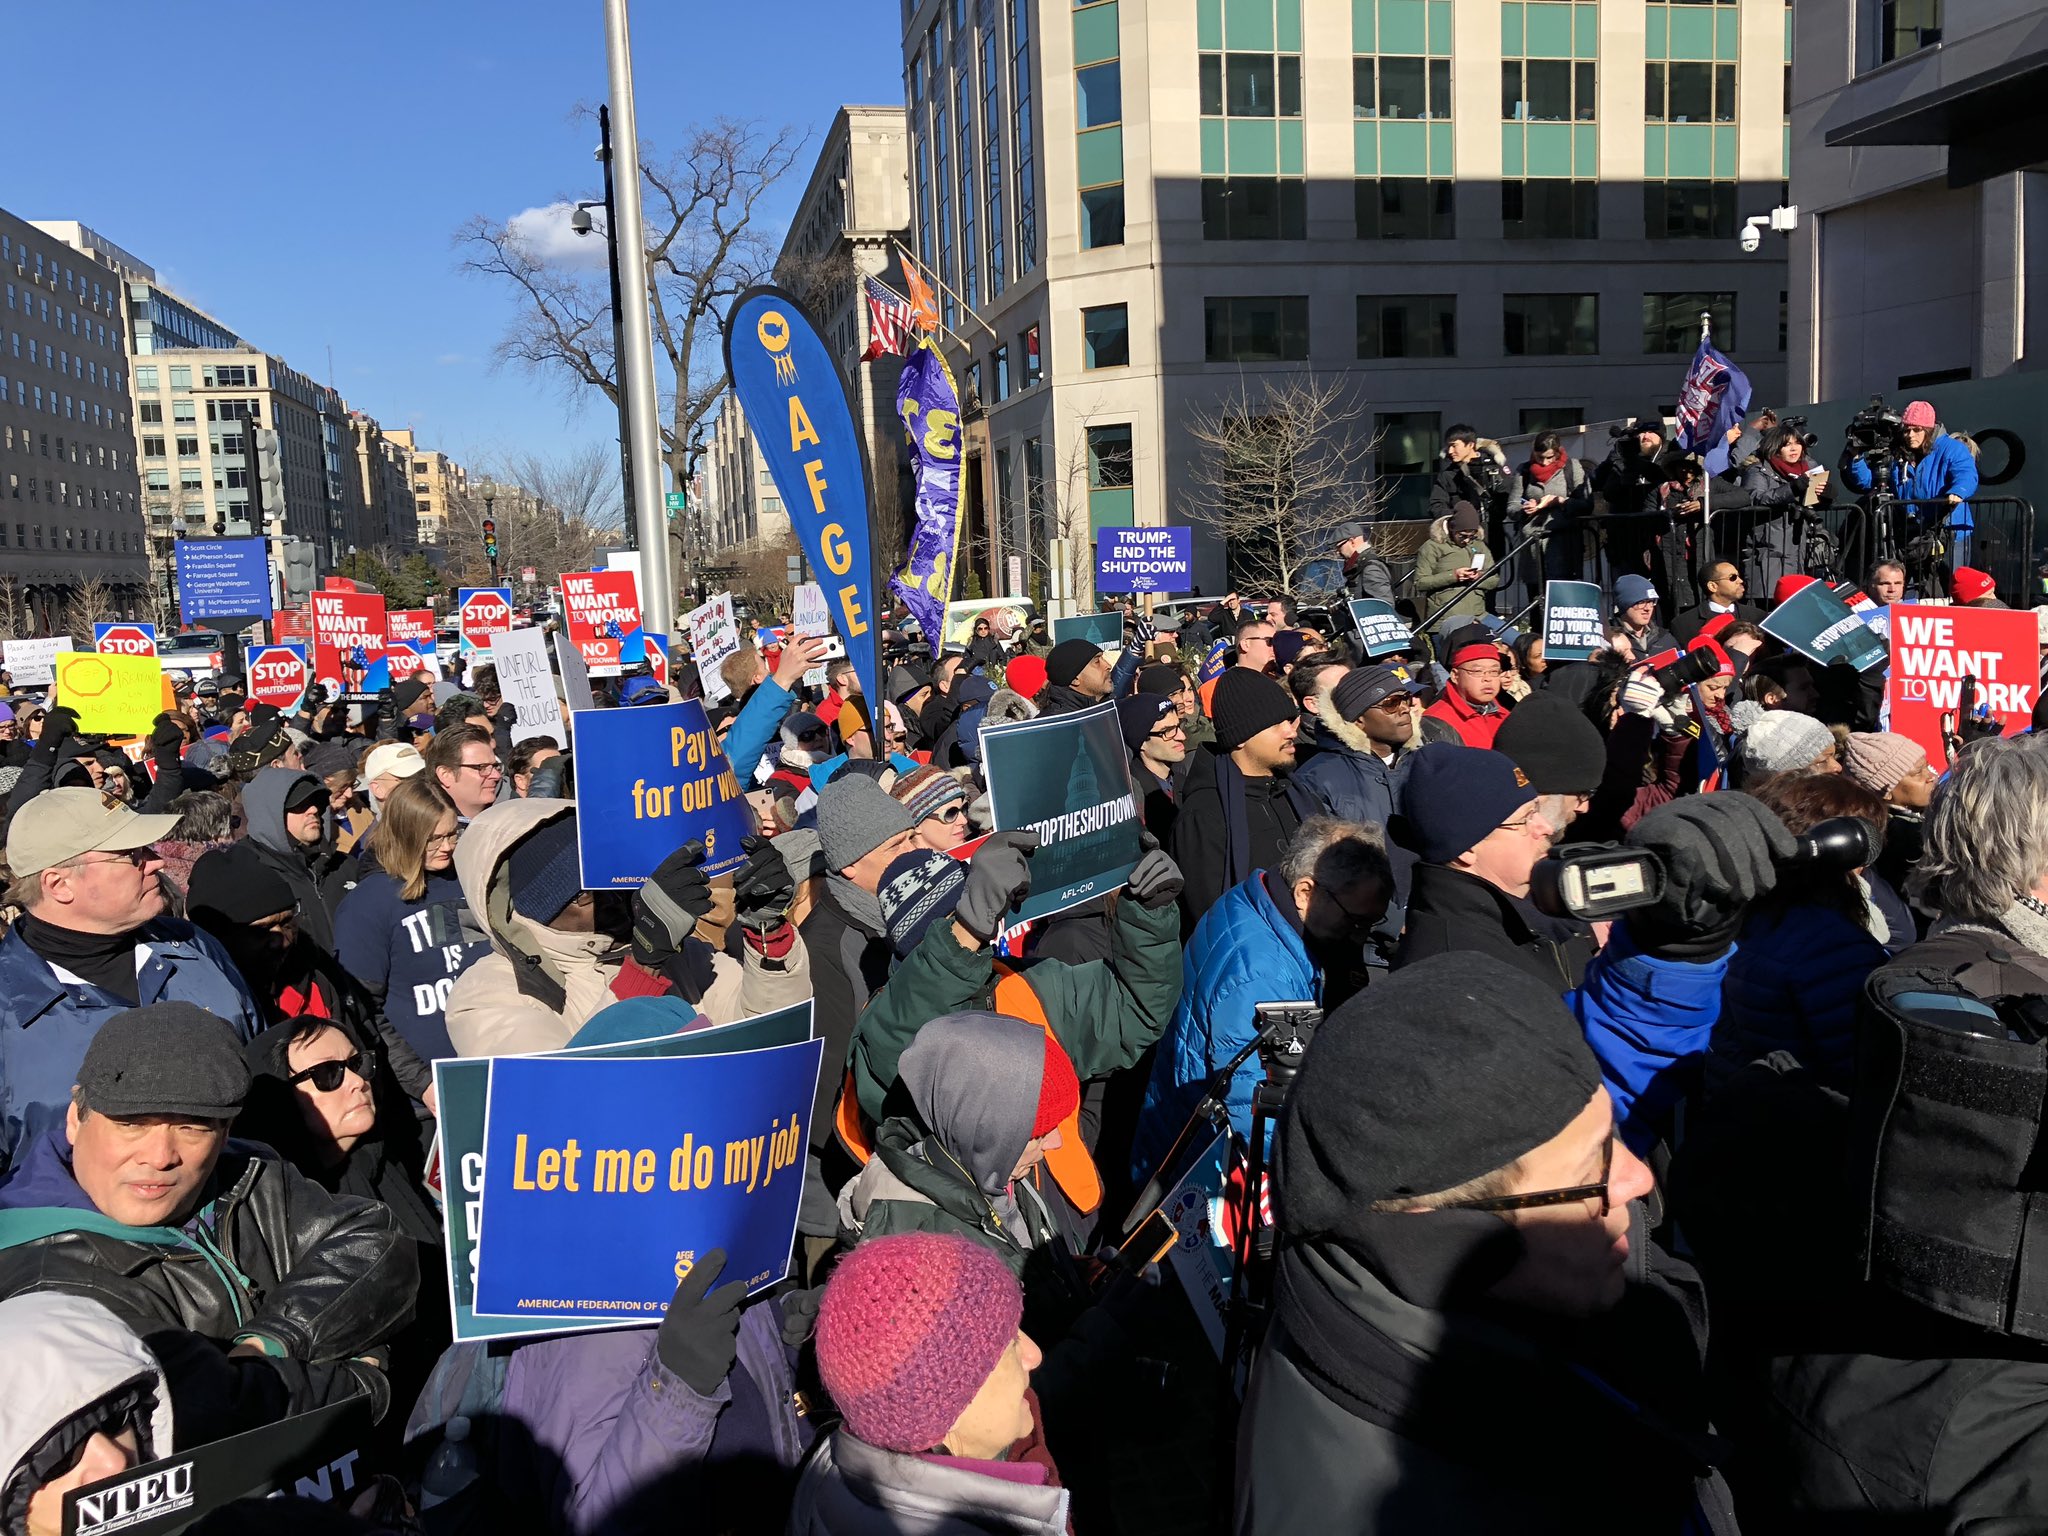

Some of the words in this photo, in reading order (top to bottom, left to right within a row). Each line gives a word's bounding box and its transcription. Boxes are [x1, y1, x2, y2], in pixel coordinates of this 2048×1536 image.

[788, 395, 868, 638] AFGE
[1117, 531, 1172, 544] TRUMP:
[1113, 546, 1145, 559] END
[1148, 546, 1176, 559] THE
[1101, 560, 1187, 574] SHUTDOWN
[192, 572, 217, 580] Farragut
[216, 580, 250, 588] Washington
[566, 579, 595, 595] WE
[315, 598, 344, 615] WE
[568, 593, 619, 611] WANT
[1843, 590, 1869, 607] THE
[390, 614, 407, 623] WE
[465, 604, 507, 621] STOP
[571, 610, 585, 621] TO
[585, 607, 637, 625] WORK
[794, 610, 827, 627] LANDLORD
[316, 615, 368, 633] WANT
[391, 622, 422, 632] WANT
[465, 625, 507, 635] SHUTDOWN
[1362, 626, 1374, 636] DO
[1376, 623, 1396, 634] YOUR
[1549, 620, 1566, 633] DO
[1566, 619, 1592, 633] YOUR
[1899, 616, 1955, 647] WE
[318, 632, 333, 643] TO
[332, 633, 384, 650] WORK
[400, 630, 432, 640] WORK
[1366, 636, 1379, 645] SO
[1379, 633, 1393, 643] WE
[1393, 631, 1407, 640] CAN
[1548, 633, 1564, 645] SO
[1565, 633, 1582, 646] WE
[102, 638, 151, 654] STOP
[581, 642, 609, 657] NO
[254, 661, 301, 680] STOP
[387, 655, 421, 671] STOP
[497, 650, 547, 679] UNFURL
[1899, 647, 2003, 681] WANT
[255, 683, 302, 696] SHUTDOWN
[513, 675, 541, 701] THE
[1898, 678, 1928, 701] TO
[513, 697, 561, 729] URLOUGH
[671, 726, 705, 771] Pay
[632, 778, 675, 820] for
[681, 775, 714, 813] our
[1060, 881, 1094, 901] AFL-CIO
[441, 944, 463, 973] IS
[513, 1133, 582, 1192] Let
[593, 1148, 657, 1193] me
[669, 1132, 714, 1192] do
[723, 1135, 766, 1194] my
[763, 1113, 800, 1187] job
[675, 1250, 695, 1260] AFGE
[517, 1298, 574, 1309] AMERICAN
[577, 1299, 641, 1310] FEDERATION
[644, 1301, 658, 1311] OF
[75, 1463, 193, 1530] NTEU
[136, 1503, 172, 1521] Employees
[172, 1496, 194, 1509] Union
